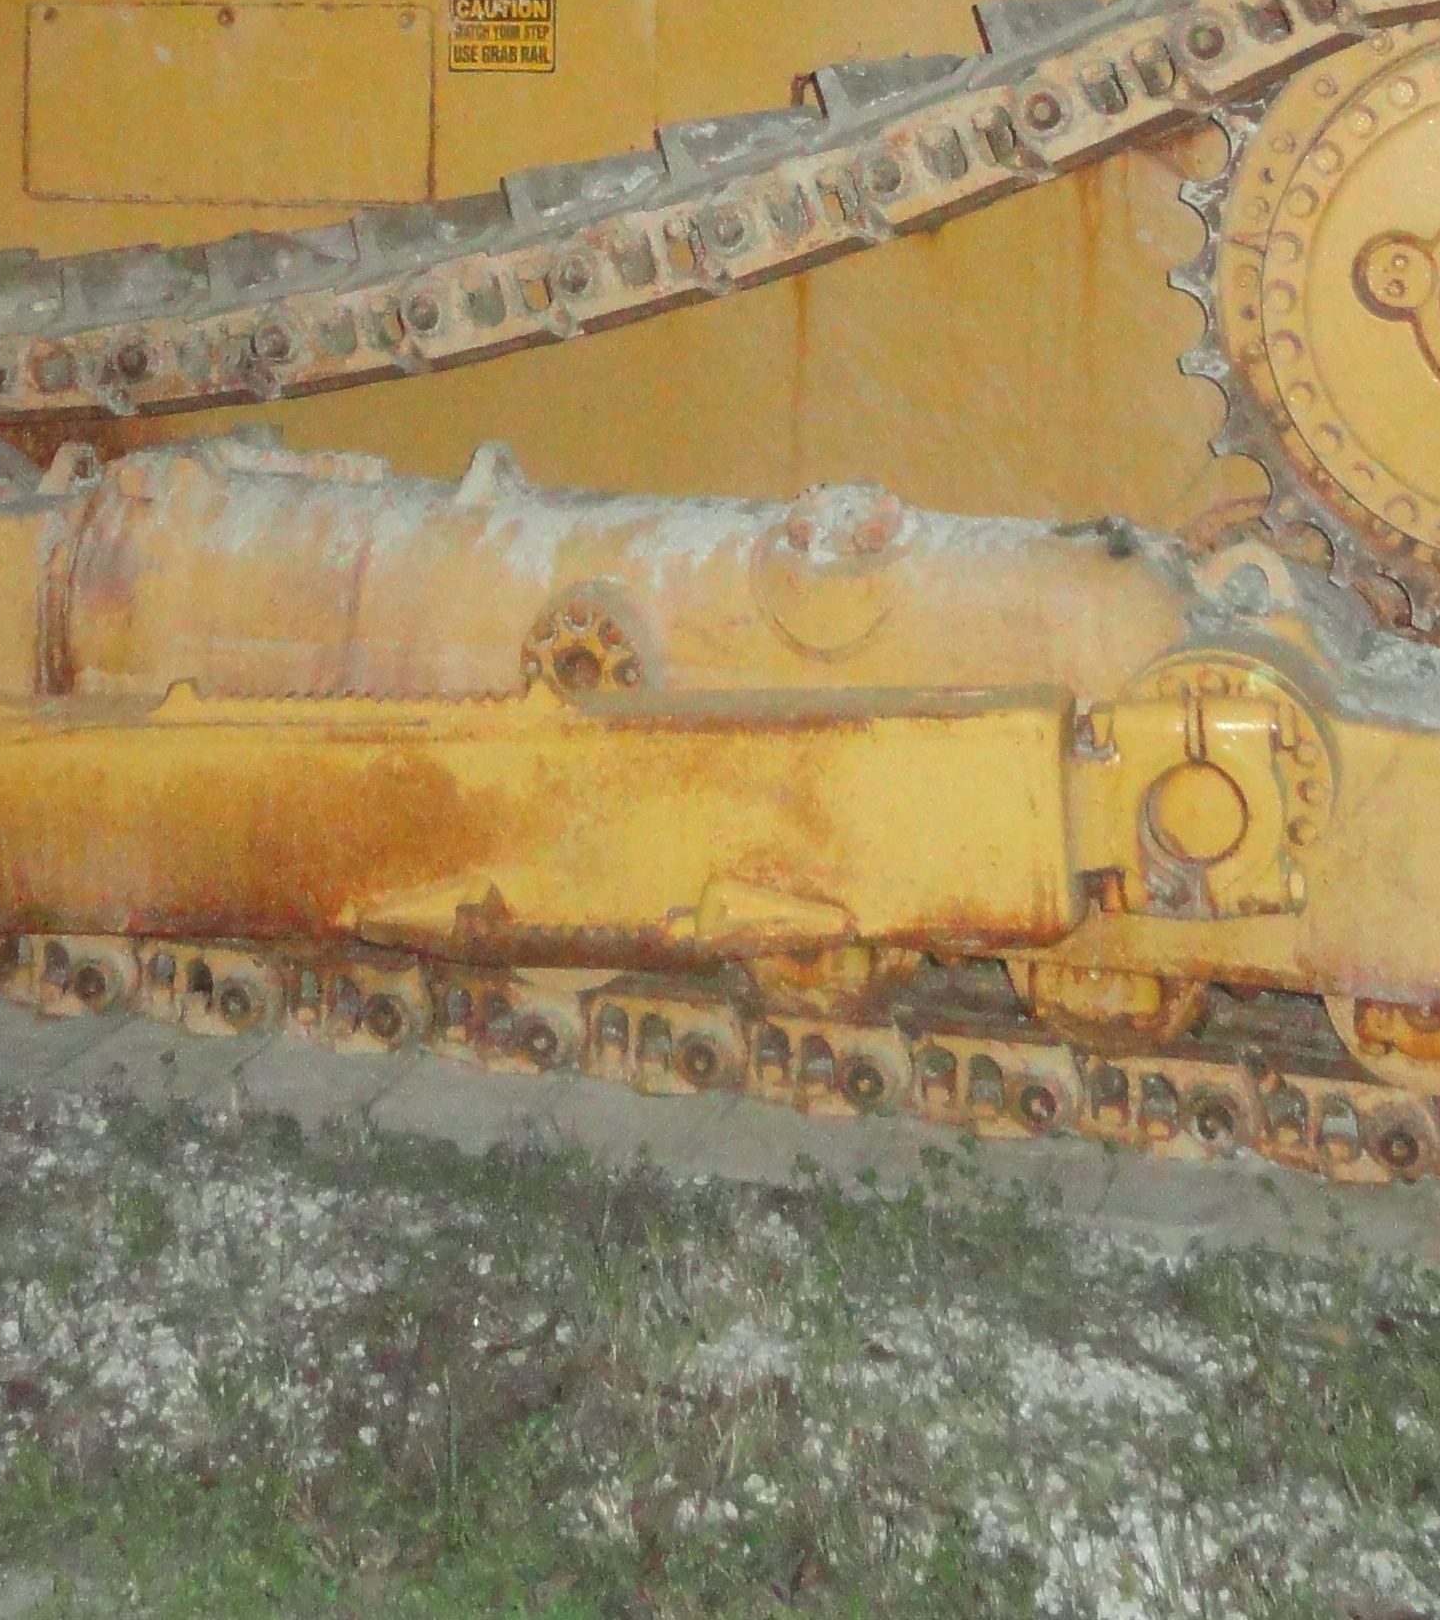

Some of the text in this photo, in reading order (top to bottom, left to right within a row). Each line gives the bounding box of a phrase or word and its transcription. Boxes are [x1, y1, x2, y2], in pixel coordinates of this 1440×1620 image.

[524, 25, 550, 40] STEP
[454, 45, 478, 63] USE
[482, 45, 517, 63] GRAB
